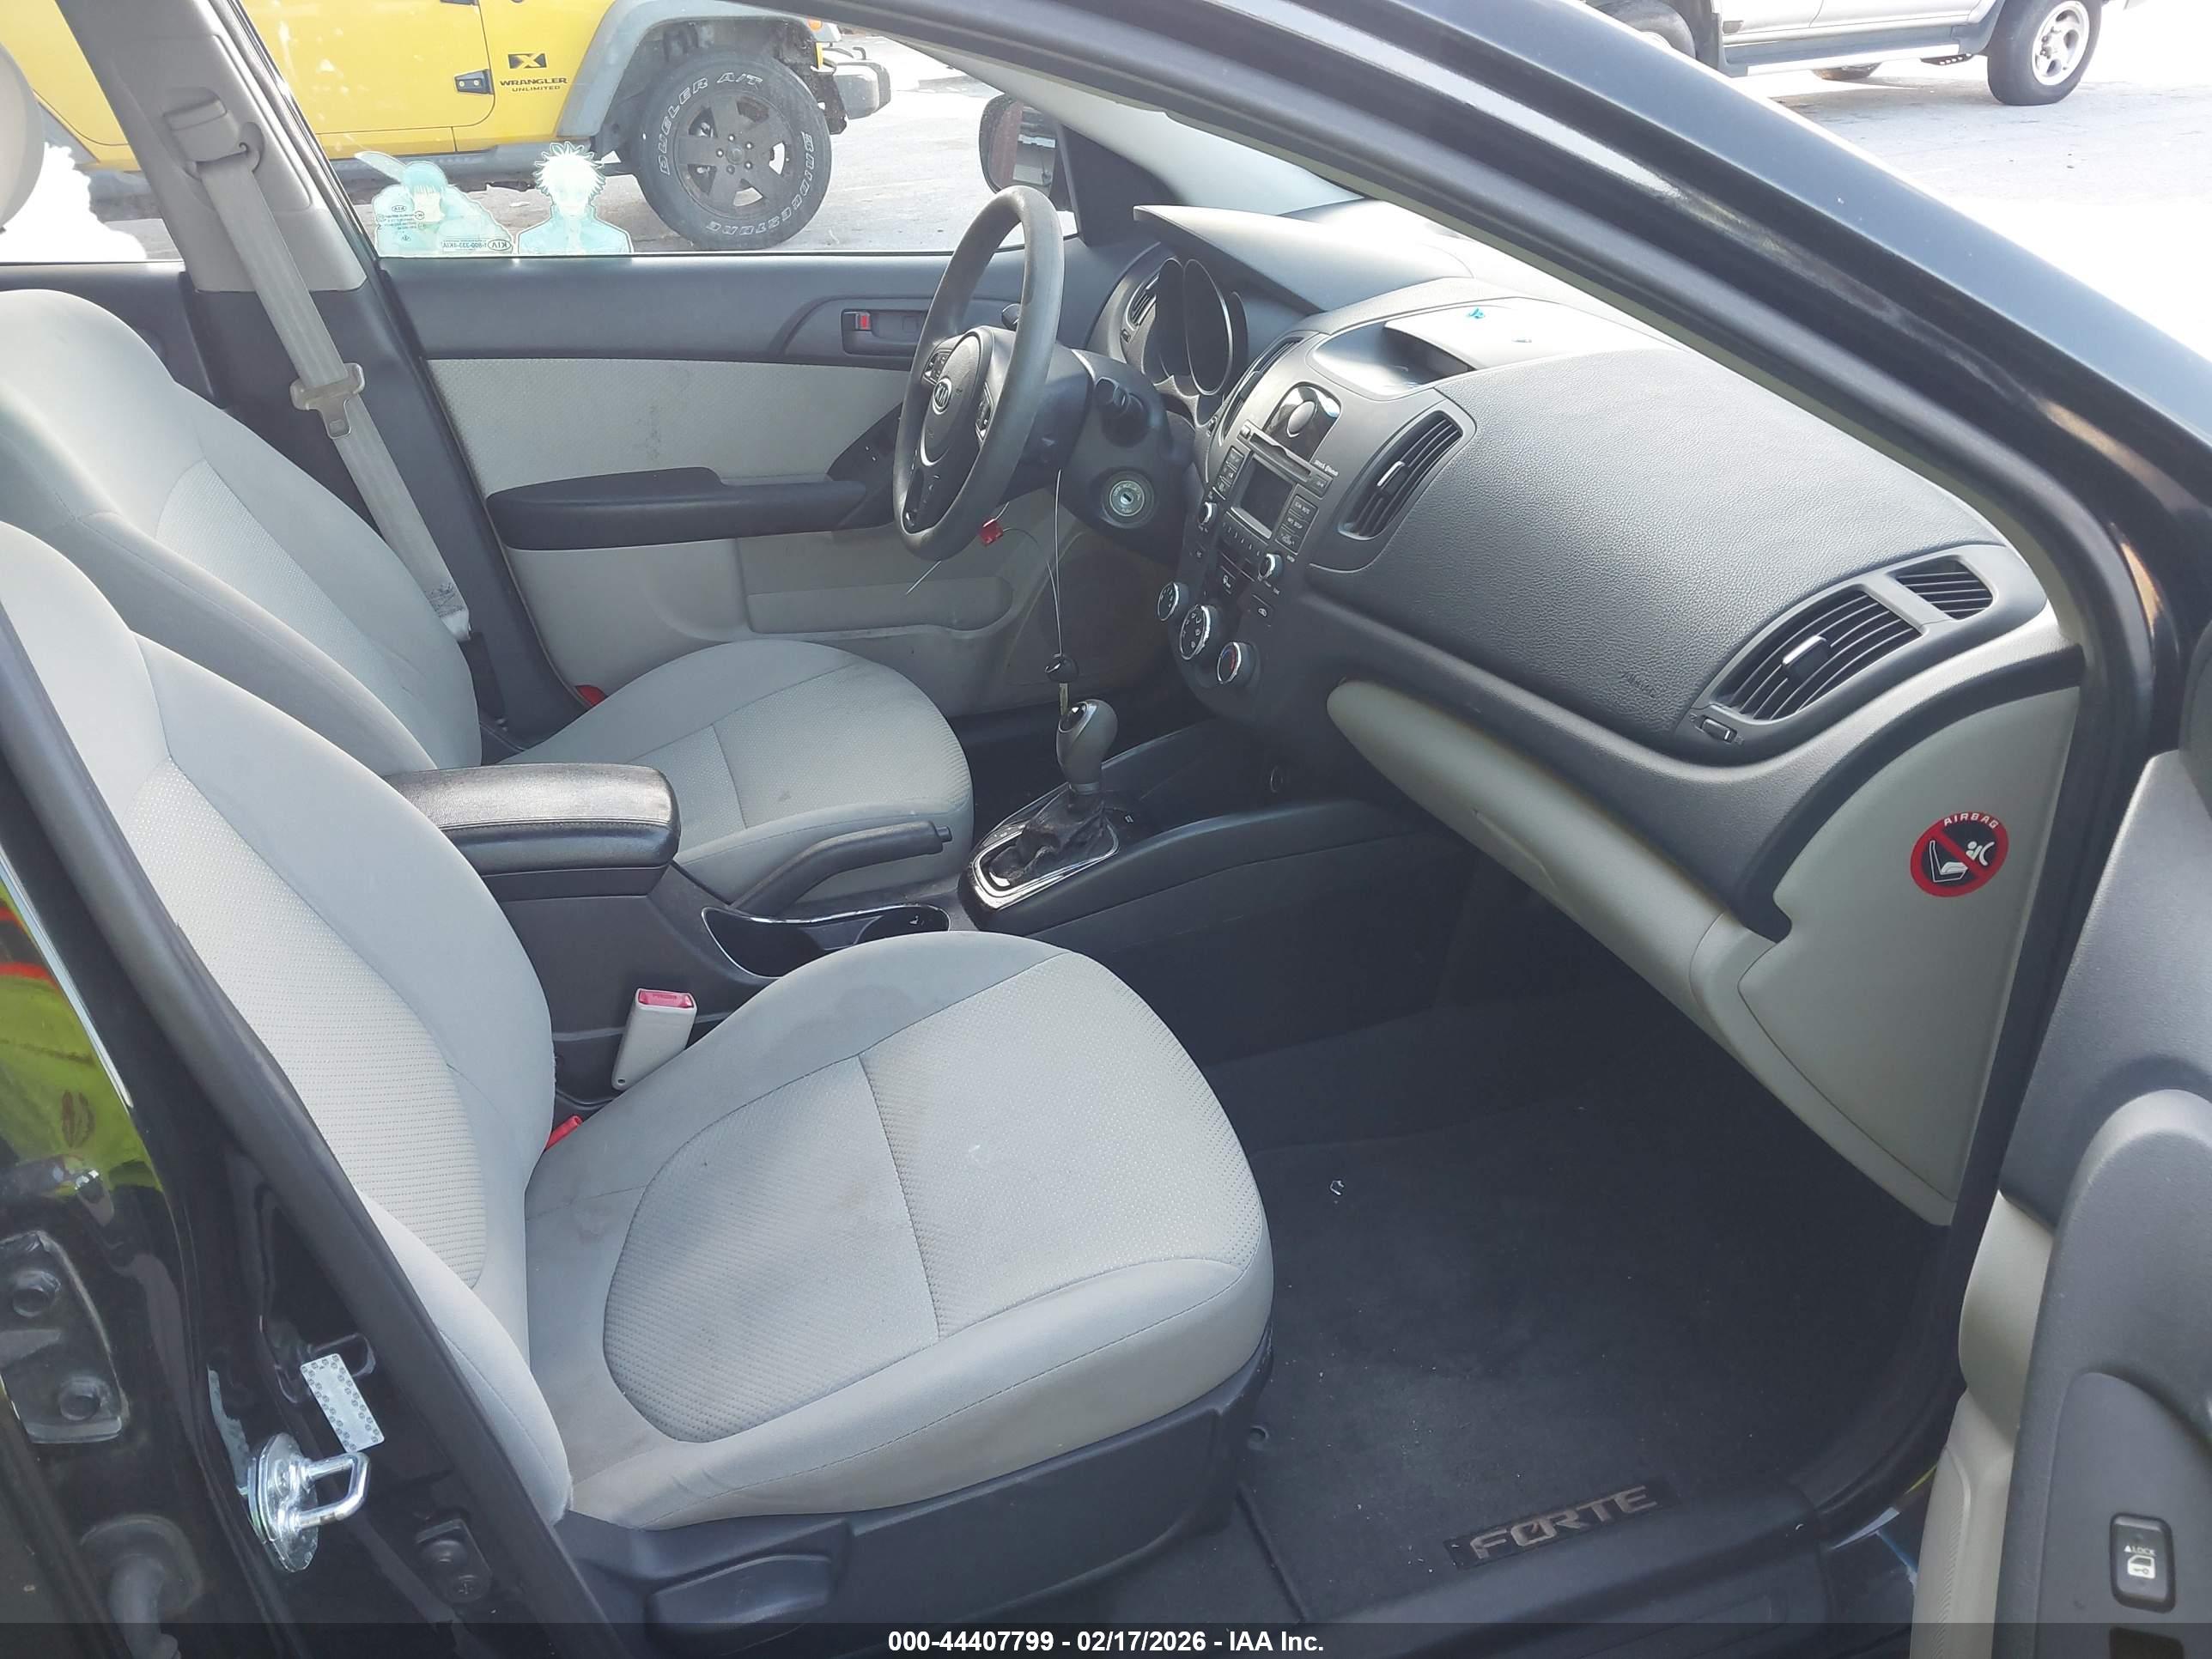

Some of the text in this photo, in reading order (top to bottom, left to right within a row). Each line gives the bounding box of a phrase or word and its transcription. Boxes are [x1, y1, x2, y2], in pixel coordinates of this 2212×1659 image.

[500, 77, 568, 86] WRANGLER
[658, 72, 763, 175] DUELER A/T
[706, 131, 815, 235] BRIDGESTONE
[934, 383, 948, 406] KIA
[1944, 812, 1999, 829] AIRBAG
[1469, 1485, 1657, 1559] FORTE
[2130, 1546, 2156, 1556] LOCK
